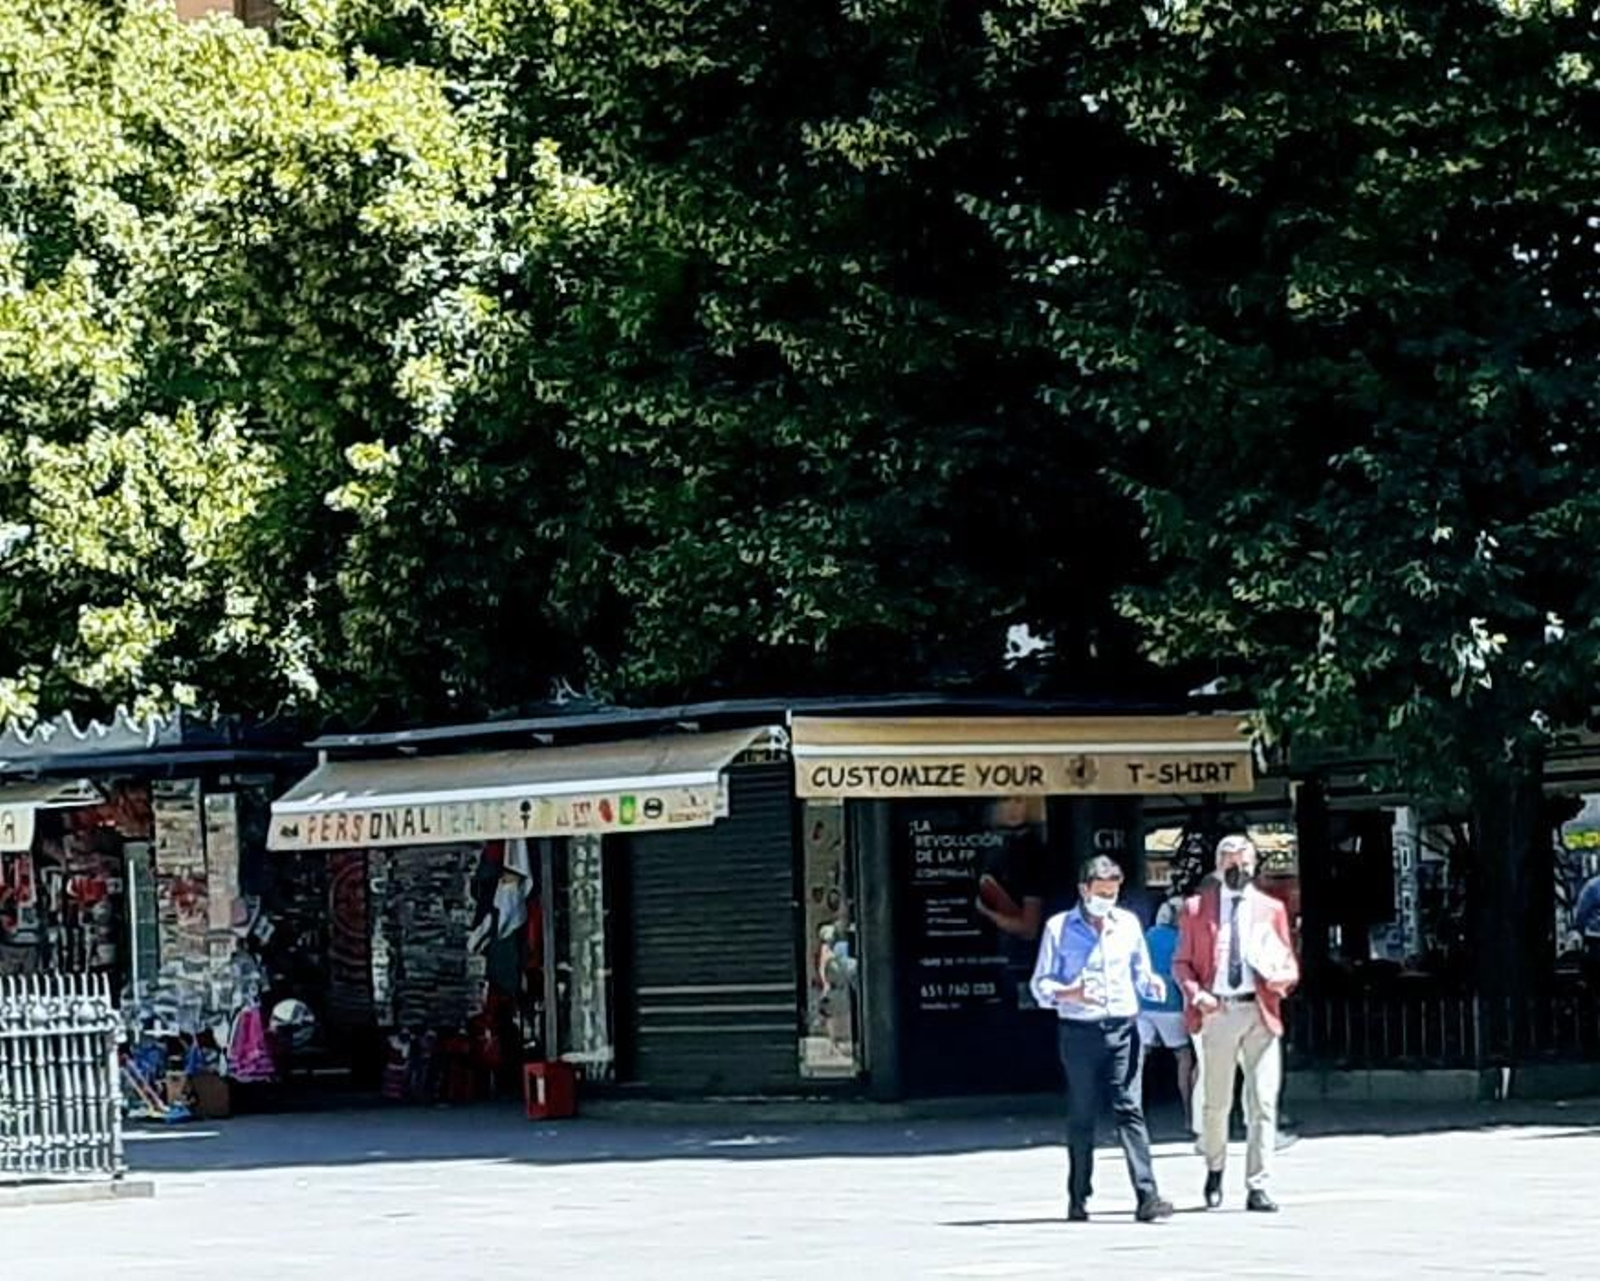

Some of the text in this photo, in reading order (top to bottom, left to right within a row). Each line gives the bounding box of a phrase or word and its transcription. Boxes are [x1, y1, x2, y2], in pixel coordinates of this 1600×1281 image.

[811, 761, 1236, 788] CUSTOMIZE YOUR T-SHIRT
[915, 849, 932, 863] DE
[938, 849, 954, 863] LA
